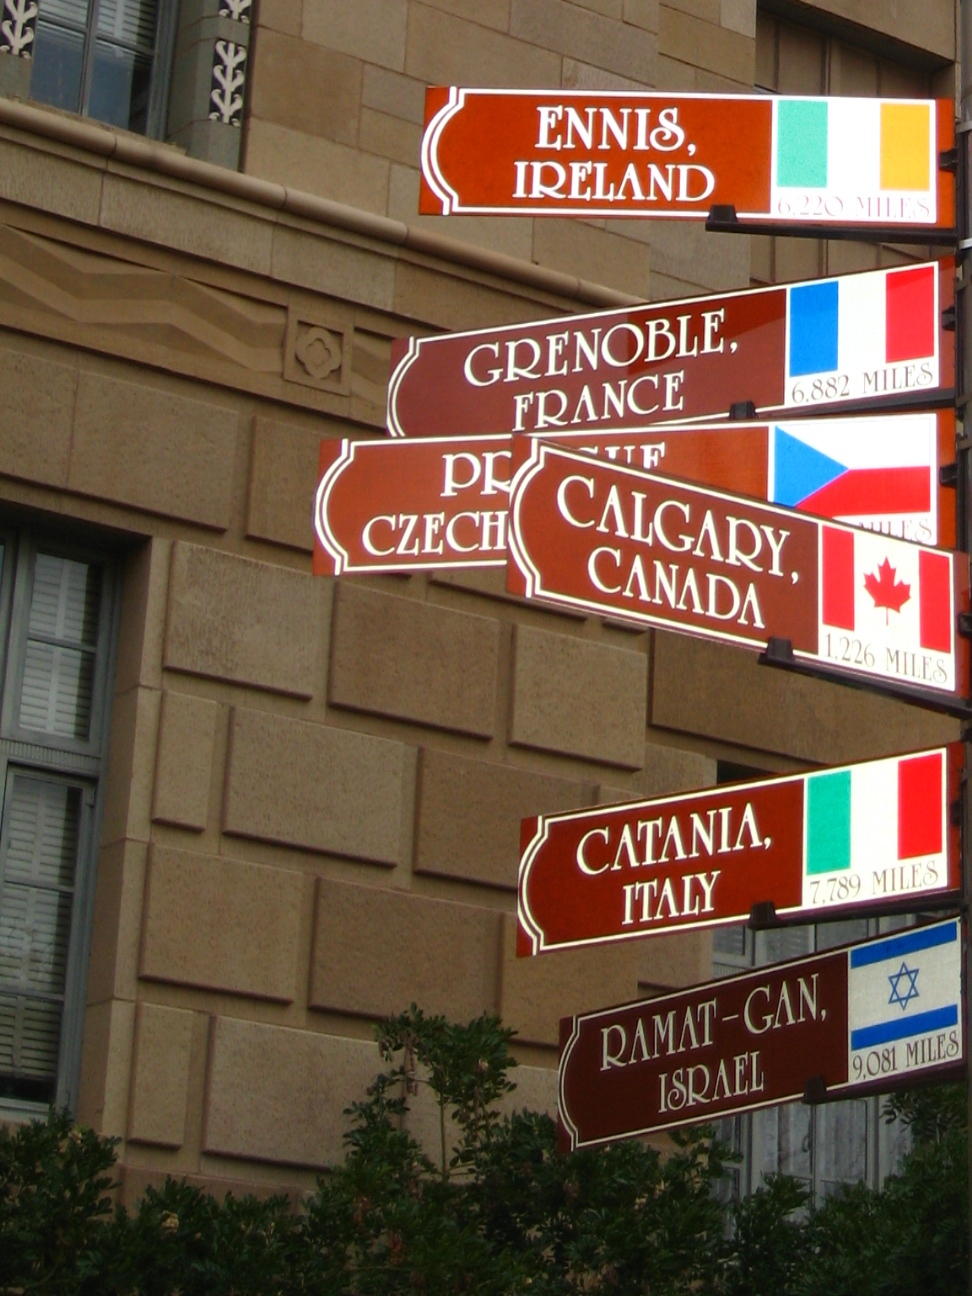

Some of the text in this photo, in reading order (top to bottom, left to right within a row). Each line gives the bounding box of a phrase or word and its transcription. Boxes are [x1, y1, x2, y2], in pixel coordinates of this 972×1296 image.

[534, 105, 697, 157] ENNIS,
[512, 161, 716, 202] IRELAND
[856, 196, 931, 218] MILES
[464, 308, 739, 387] GRENOBLE,
[512, 370, 685, 432] FRANCE
[791, 362, 934, 405] 6,882 MILES
[362, 510, 509, 556] CZECH
[556, 474, 799, 586] CALGARY,
[587, 547, 766, 630] CANADA
[824, 632, 948, 684] 1,226 MILES
[575, 802, 772, 876] CATANIA,
[621, 870, 721, 926] ITALY
[808, 860, 939, 905] 7,789 MILES
[852, 1030, 959, 1081] 9,081 MILES
[658, 1051, 764, 1114] ISRAEL
